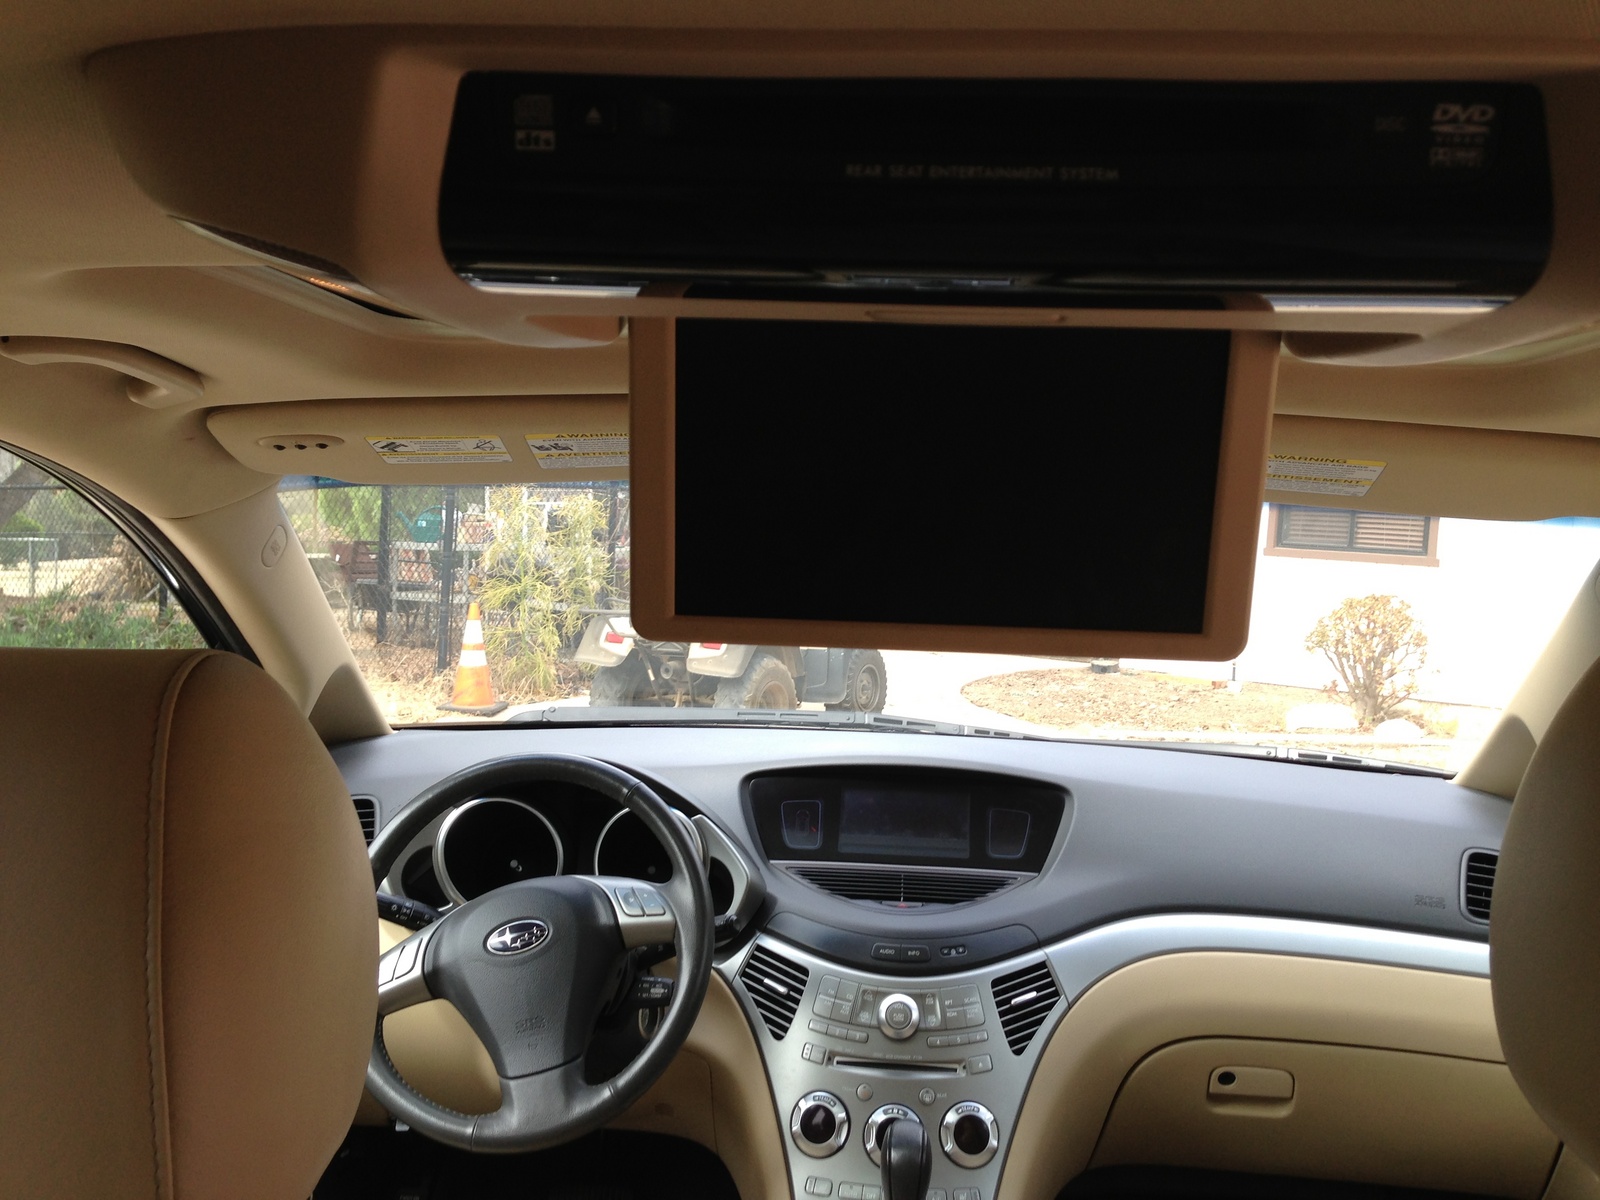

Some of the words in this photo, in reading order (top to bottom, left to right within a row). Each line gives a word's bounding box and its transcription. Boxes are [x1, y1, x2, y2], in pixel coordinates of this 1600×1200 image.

[1431, 103, 1496, 122] DVD
[845, 164, 883, 177] REAR
[888, 164, 926, 178] SEAT
[928, 164, 1053, 180] ENTERTAINMENT
[1058, 166, 1120, 181] SYSTEM
[1273, 454, 1348, 464] WARNING
